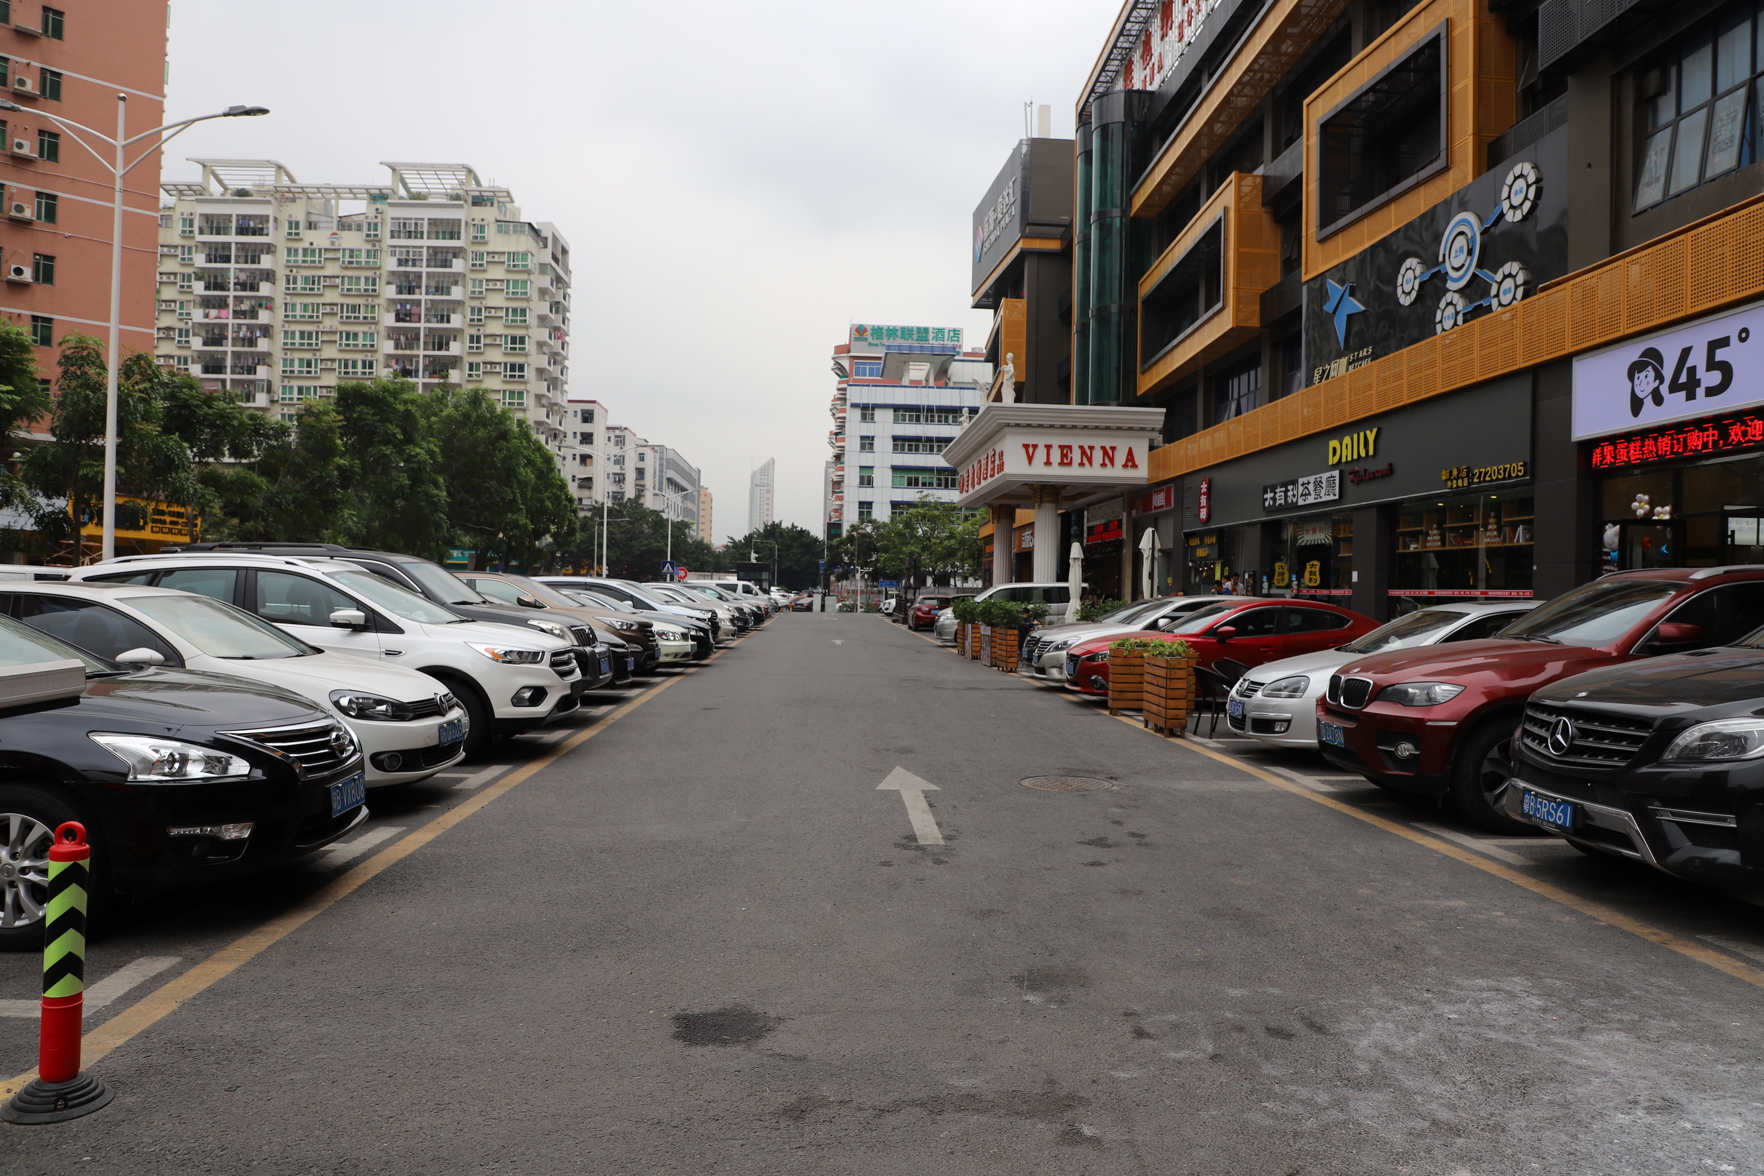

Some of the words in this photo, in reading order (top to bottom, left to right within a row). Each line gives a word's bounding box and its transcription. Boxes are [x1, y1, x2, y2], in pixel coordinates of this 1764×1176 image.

[870, 325, 961, 343] 格林联盟酒店
[1021, 443, 1139, 469] VIENNA
[1328, 427, 1379, 465] DAILY
